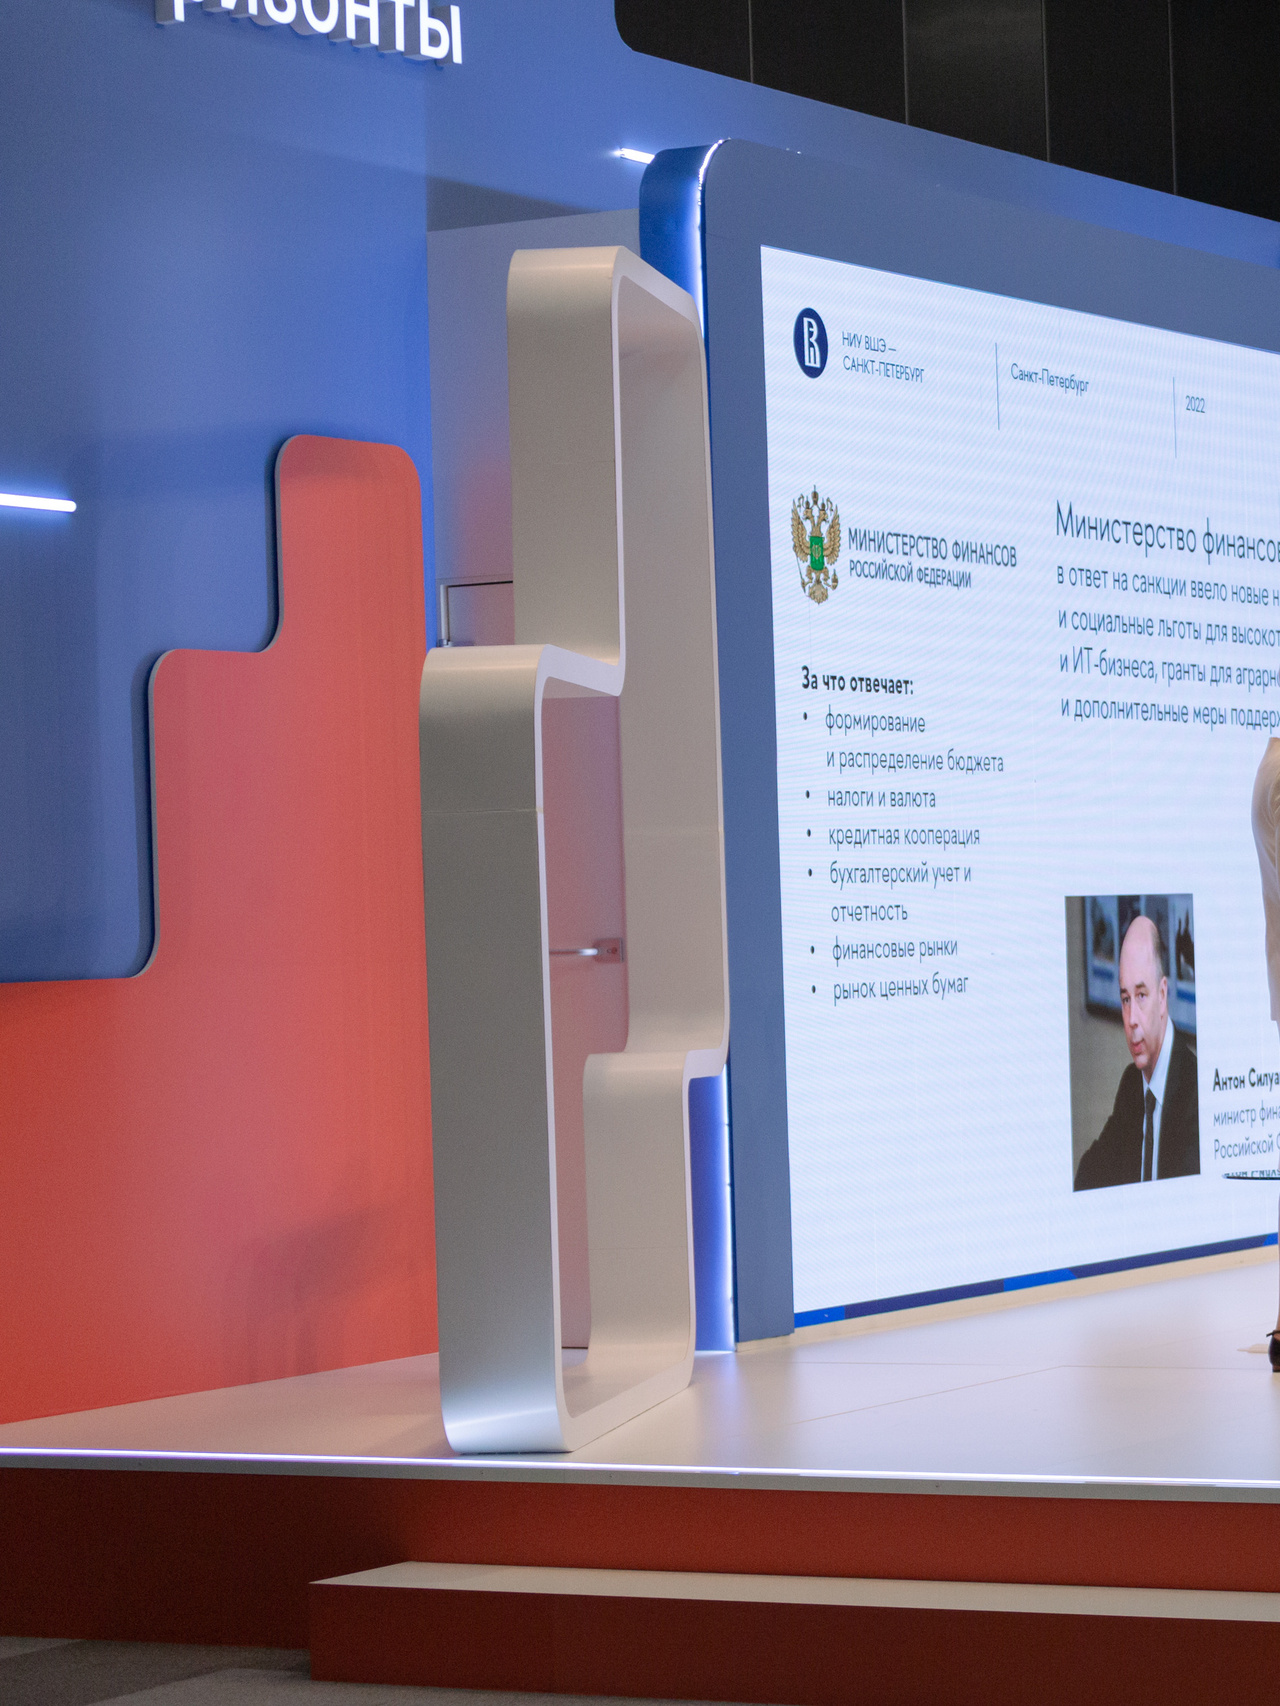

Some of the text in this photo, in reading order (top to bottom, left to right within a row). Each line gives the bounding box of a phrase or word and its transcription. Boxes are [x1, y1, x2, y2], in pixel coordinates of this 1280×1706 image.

[172, 0, 463, 64] онты
[842, 331, 862, 349] НИУ
[864, 335, 887, 353] ВШЭ
[842, 355, 925, 383] САНКТ-ПЕТЕРБУРГ
[1010, 363, 1090, 396] Санкт-Петербург
[1185, 395, 1206, 413] 2022
[1056, 499, 1197, 558] Министерство
[848, 527, 1017, 568] МИНИСТЕРСТВО ФИНАНСОВ
[849, 559, 972, 590] РОССИЙСКОЙ ФЕДЕРАЦИИ
[1056, 565, 1065, 585] в
[1068, 567, 1109, 589] ответ
[1112, 570, 1129, 592] на
[1132, 573, 1187, 599] санкции
[1190, 580, 1228, 602] ввело
[1231, 584, 1269, 606] новые
[1058, 609, 1067, 629] и
[1071, 610, 1154, 637] социальные
[1157, 618, 1202, 640] льготы
[1205, 622, 1228, 646] для
[801, 665, 914, 696] За что отвечает:
[1059, 653, 1068, 673] и
[1072, 645, 1159, 683] ИТ-бизнеса,
[1161, 660, 1206, 688] гранты
[1209, 664, 1233, 688] для
[825, 704, 926, 737] формирование
[1061, 698, 1070, 717] и
[1074, 698, 1190, 724] дополнительные
[1192, 705, 1228, 732] меры
[826, 748, 1004, 775] и распределение бюджета
[827, 788, 936, 809] налоги и валюта
[828, 828, 980, 850] кредитная кооперация
[829, 859, 972, 891] бухгалтерский учет и
[831, 903, 908, 922] отчетность
[832, 935, 958, 967] финансовые рынки
[833, 971, 968, 1006] рынок ценных бумаг
[1212, 1067, 1246, 1092] Антон
[1213, 1108, 1257, 1129] министр
[1214, 1132, 1275, 1160] Российской
